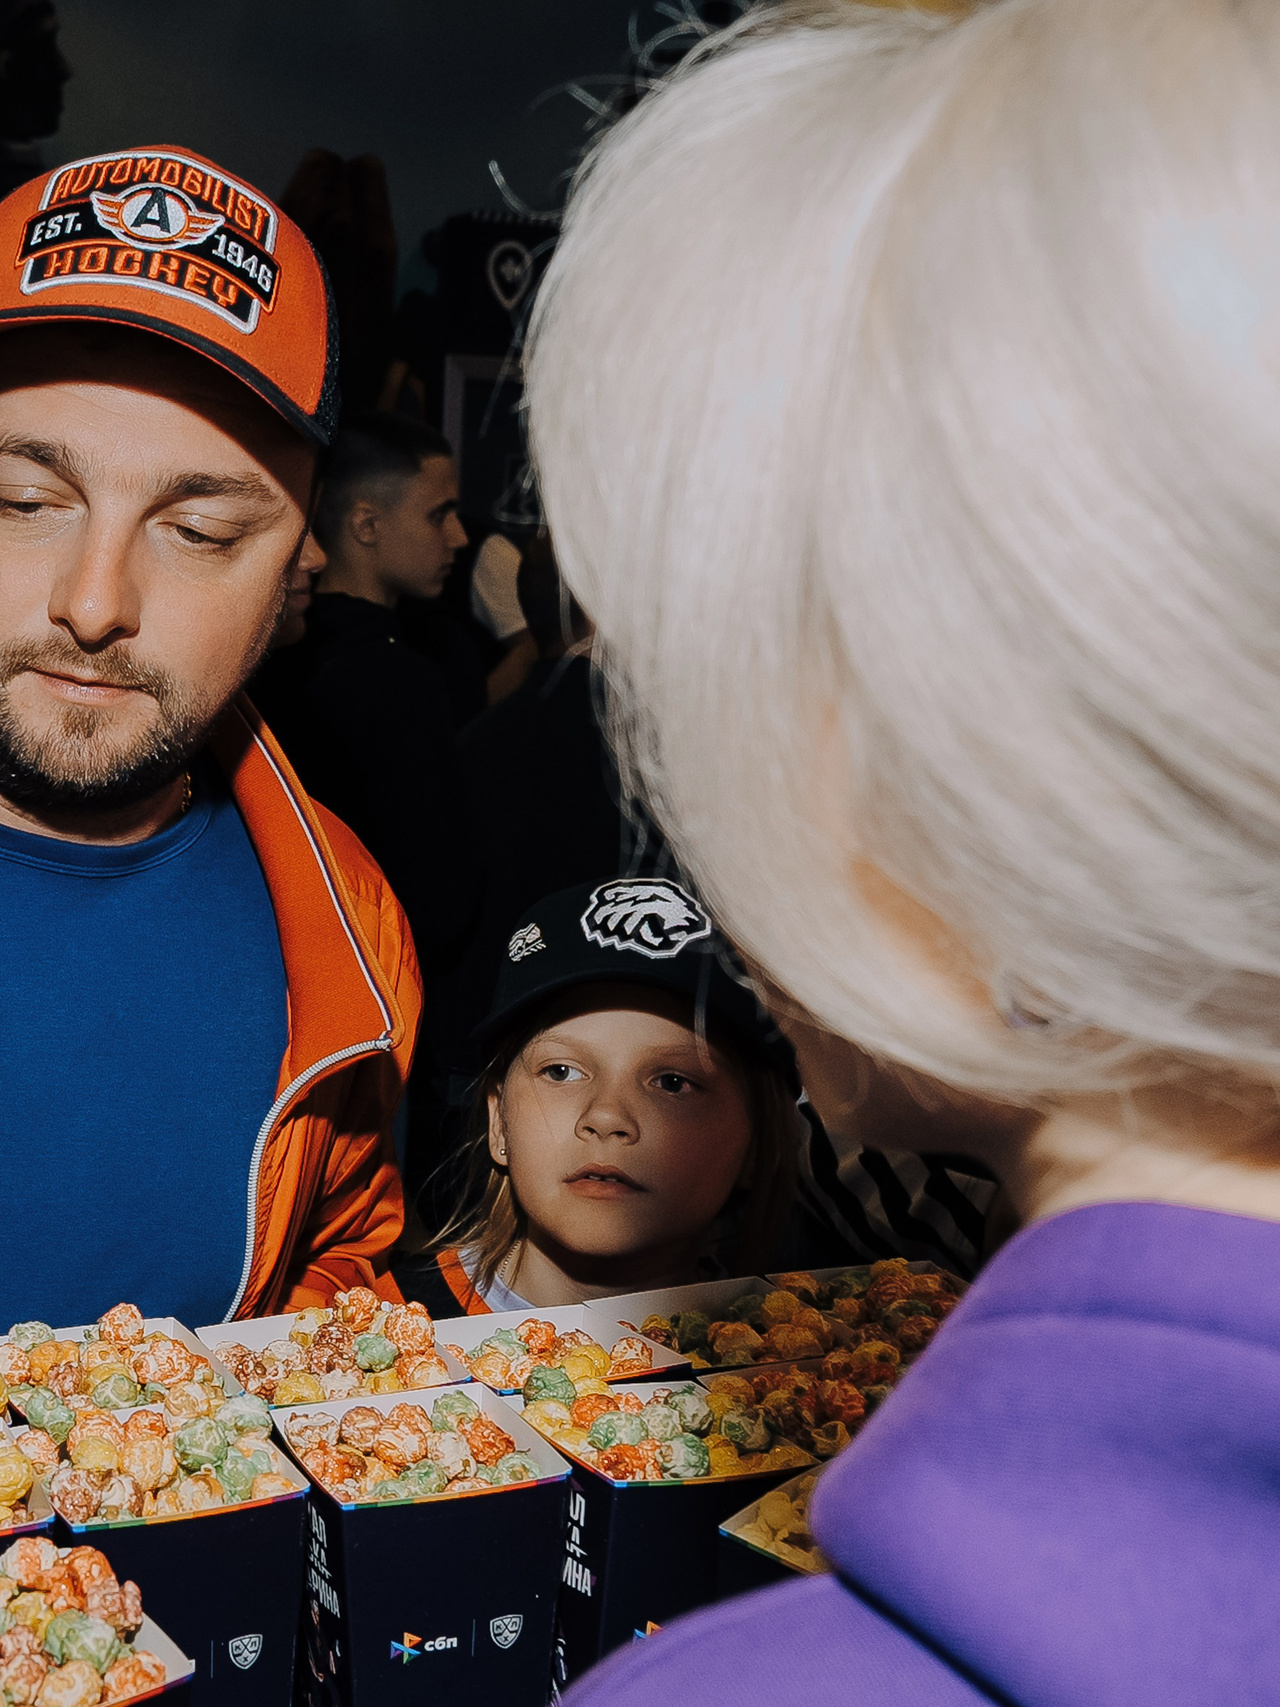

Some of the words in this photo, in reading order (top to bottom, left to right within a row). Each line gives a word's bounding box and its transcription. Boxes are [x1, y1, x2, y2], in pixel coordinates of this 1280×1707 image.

[49, 156, 270, 241] AUTOMOBILIST
[129, 188, 172, 234] A
[30, 211, 83, 247] EST.
[211, 233, 274, 293] 1946
[42, 246, 240, 308] HOCKEY
[423, 1635, 459, 1652] сбп
